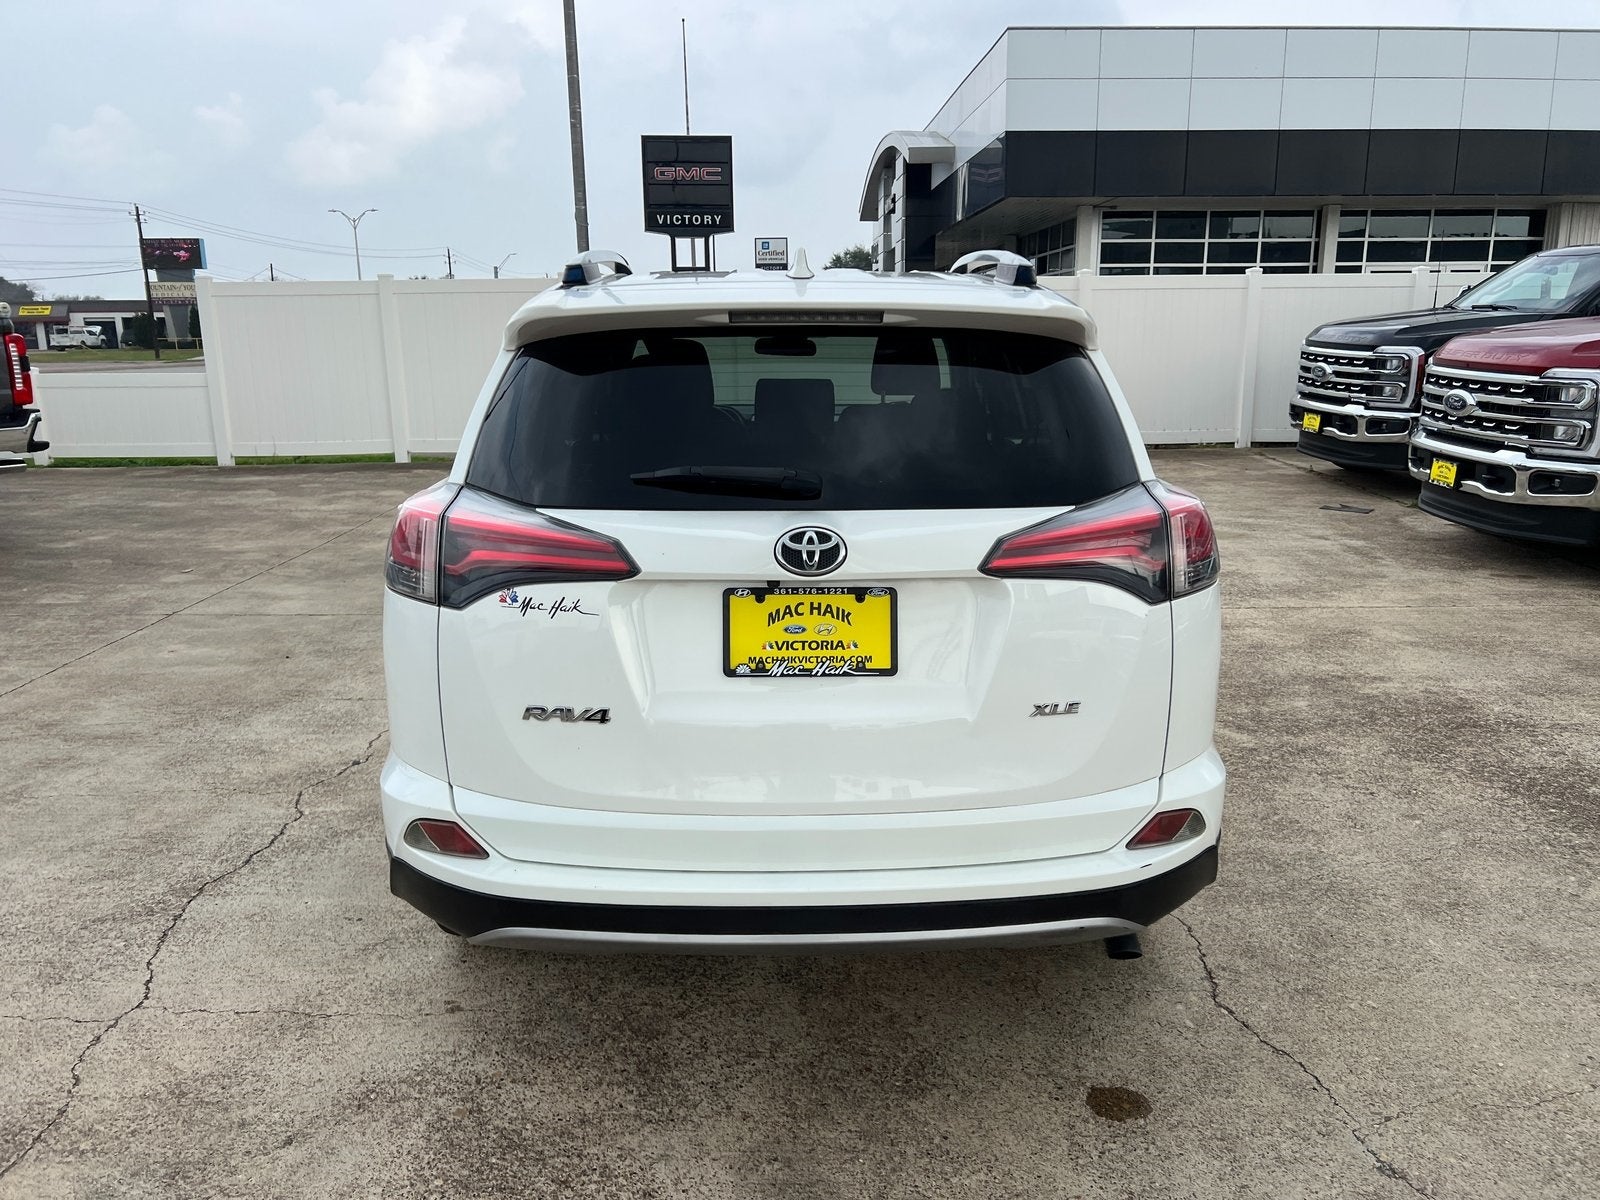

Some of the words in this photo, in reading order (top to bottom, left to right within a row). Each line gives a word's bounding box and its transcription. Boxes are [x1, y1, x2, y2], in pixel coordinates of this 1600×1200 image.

[654, 167, 722, 181] GMC
[656, 214, 722, 225] VICTORY
[520, 596, 547, 617] Mac
[548, 596, 593, 619] Haik
[767, 602, 805, 627] MAC
[809, 601, 853, 627] HAIK
[785, 625, 805, 634] Ford
[774, 640, 846, 651] VICTORIA
[768, 660, 805, 677] Mac
[811, 659, 860, 677] Haik
[522, 705, 611, 724] RAV4
[1029, 701, 1081, 717] XLE
